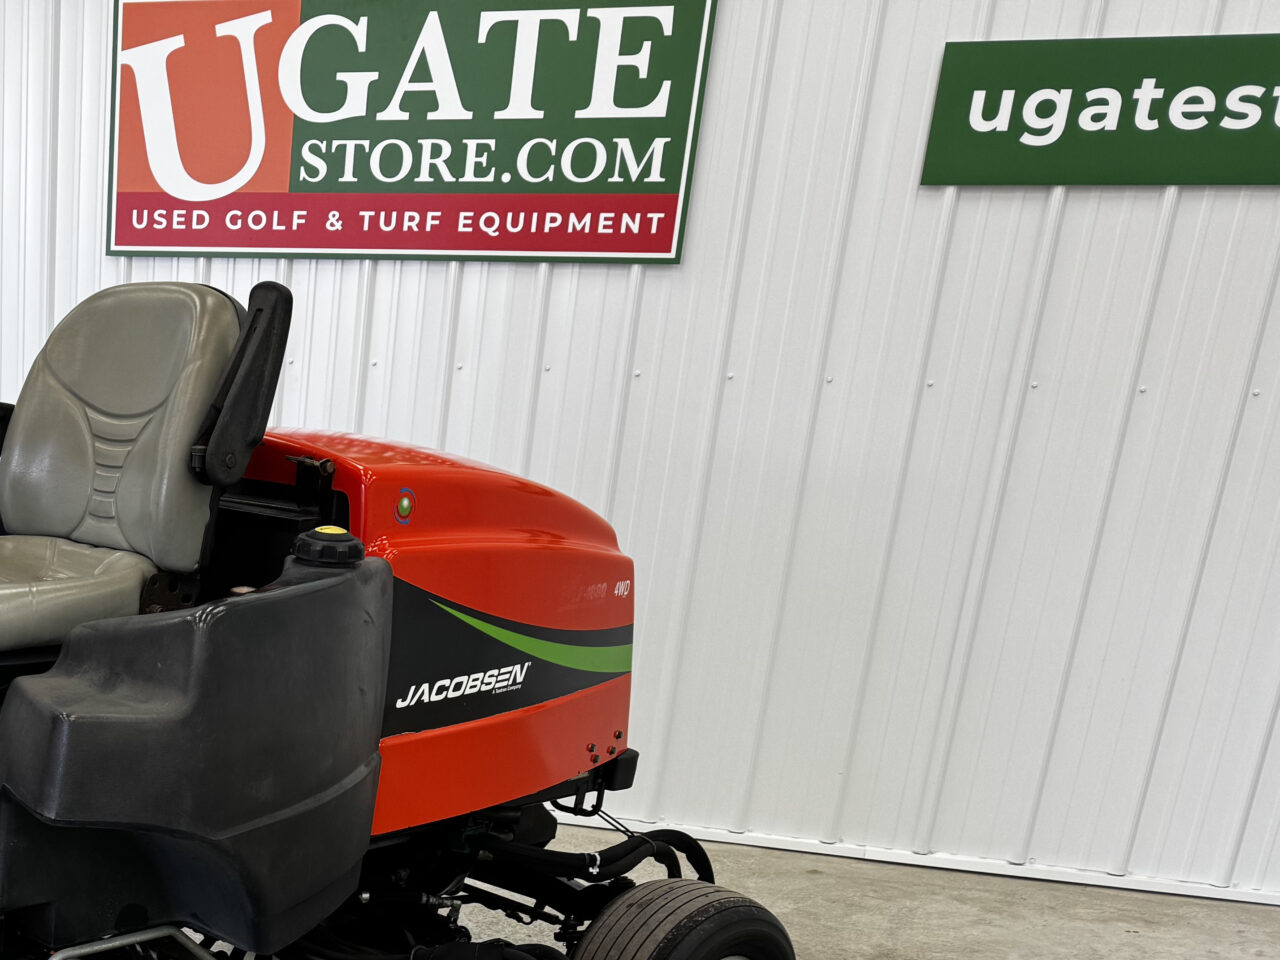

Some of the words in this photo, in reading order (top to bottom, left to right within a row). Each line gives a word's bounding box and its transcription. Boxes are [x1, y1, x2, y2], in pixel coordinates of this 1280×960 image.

[969, 77, 1280, 147] ugates
[298, 137, 672, 184] STORE.COM
[131, 209, 211, 230] USED
[225, 209, 308, 231] GOLF
[325, 210, 343, 231] &
[359, 210, 442, 232] TURF
[457, 211, 665, 237] EQUIPMENT
[614, 580, 631, 597] 4WD
[395, 661, 531, 709] JACOBSEN
